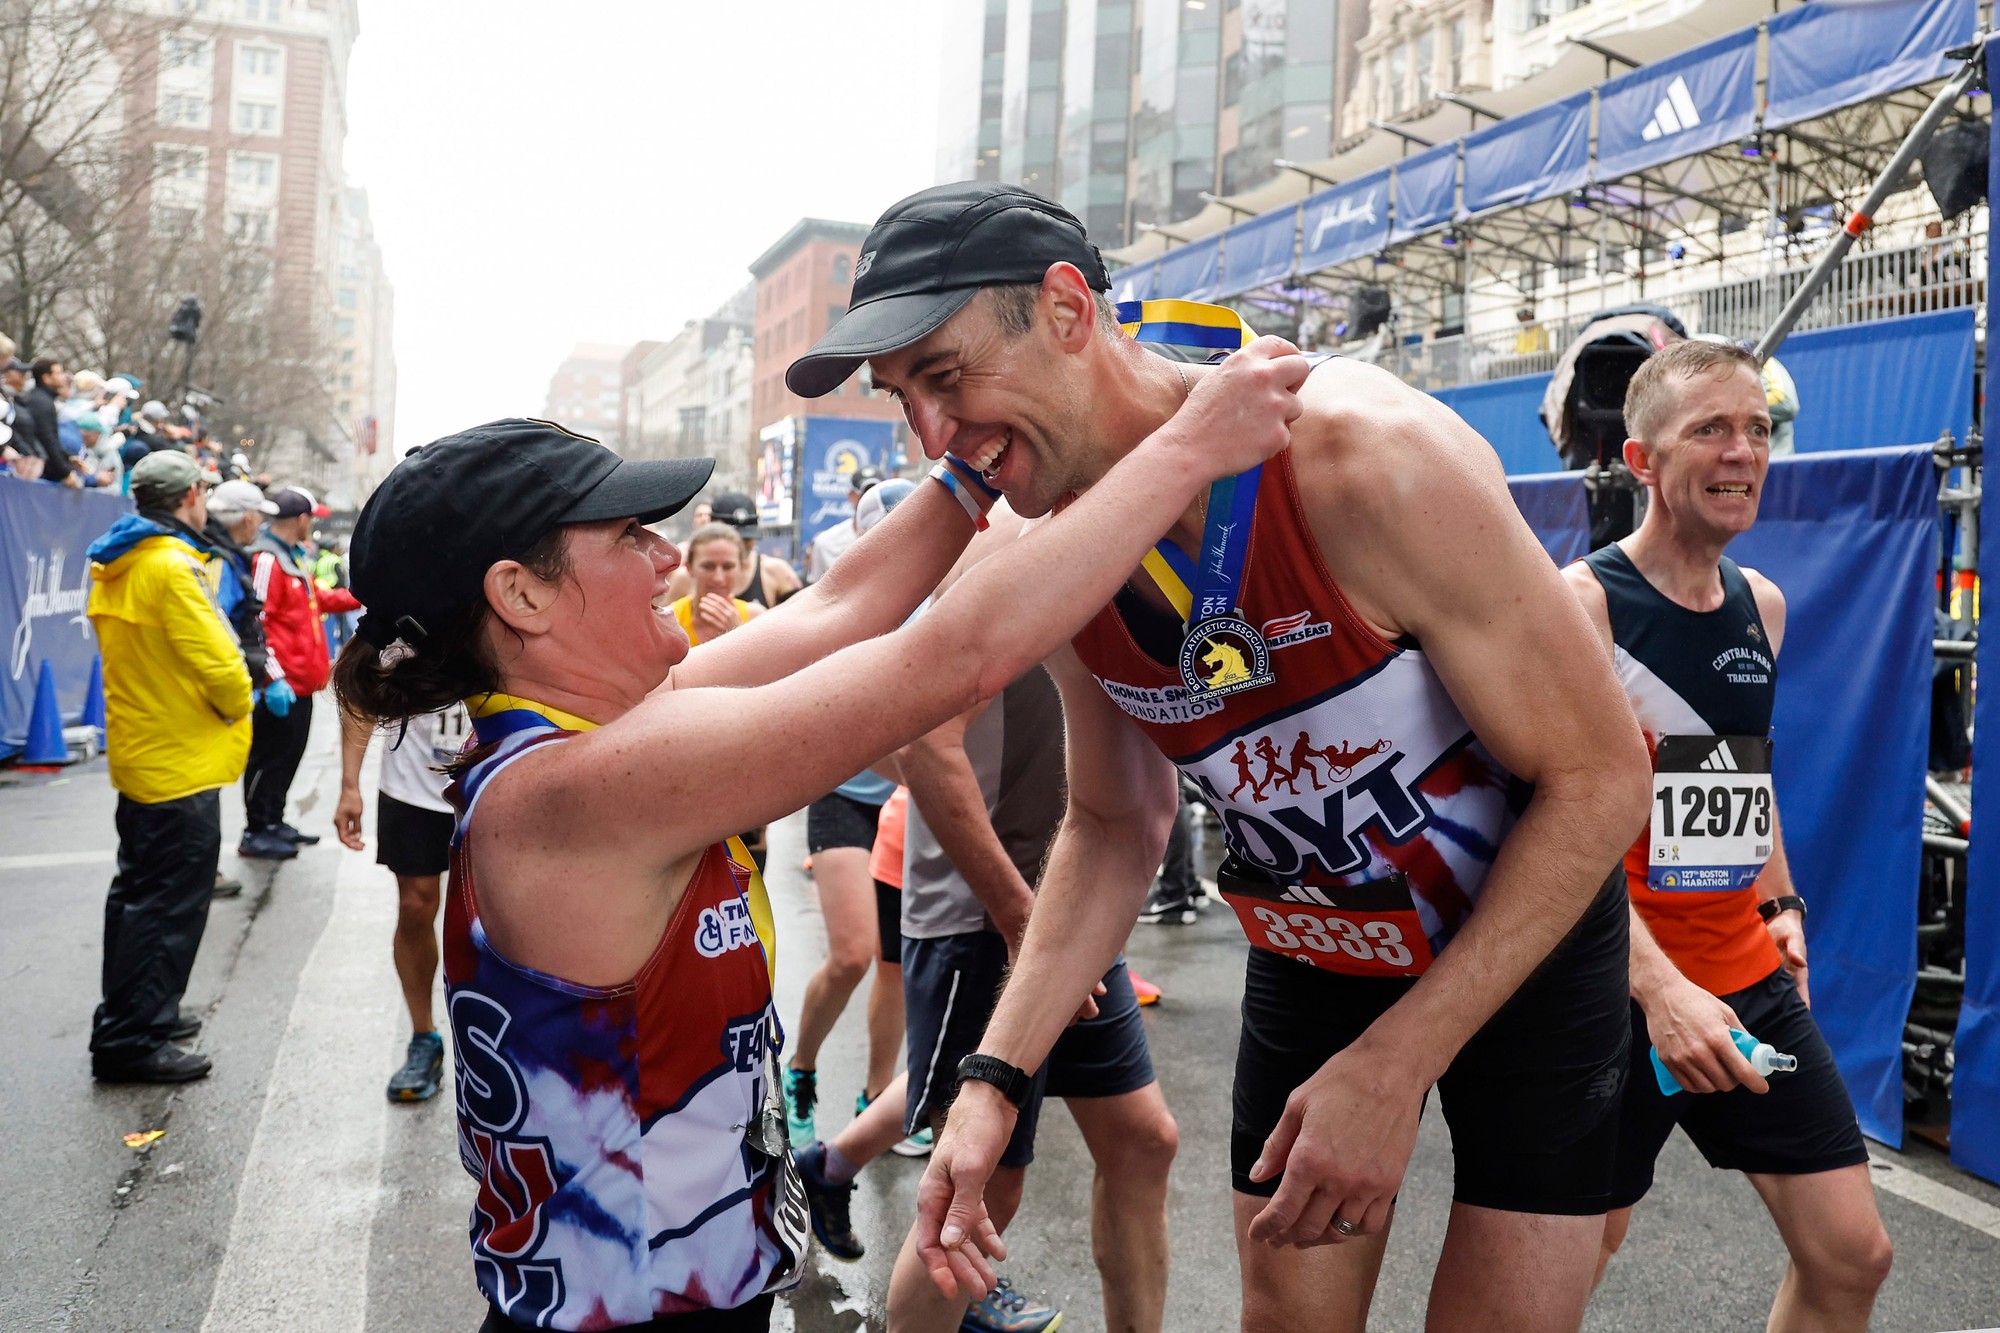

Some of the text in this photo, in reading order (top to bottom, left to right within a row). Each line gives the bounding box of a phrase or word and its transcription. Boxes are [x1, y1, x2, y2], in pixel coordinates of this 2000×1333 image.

[1304, 624, 1329, 638] EAST
[1182, 621, 1266, 692] BOSTON ATHLETIC ASSOCIATION
[1712, 647, 1772, 672] CENTRAL PARK
[1203, 686, 1231, 700] BOSTON
[1232, 675, 1273, 692] MARATHON
[1726, 673, 1768, 684] TRACK CLUB
[1106, 683, 1150, 704] THOMAS
[1151, 691, 1165, 704] E.
[1656, 785, 1771, 838] 12973
[1657, 848, 1666, 859] 5
[1682, 878, 1731, 887] MARATHON
[1699, 869, 1729, 879] BOSTON
[1253, 906, 1413, 967] 3333
